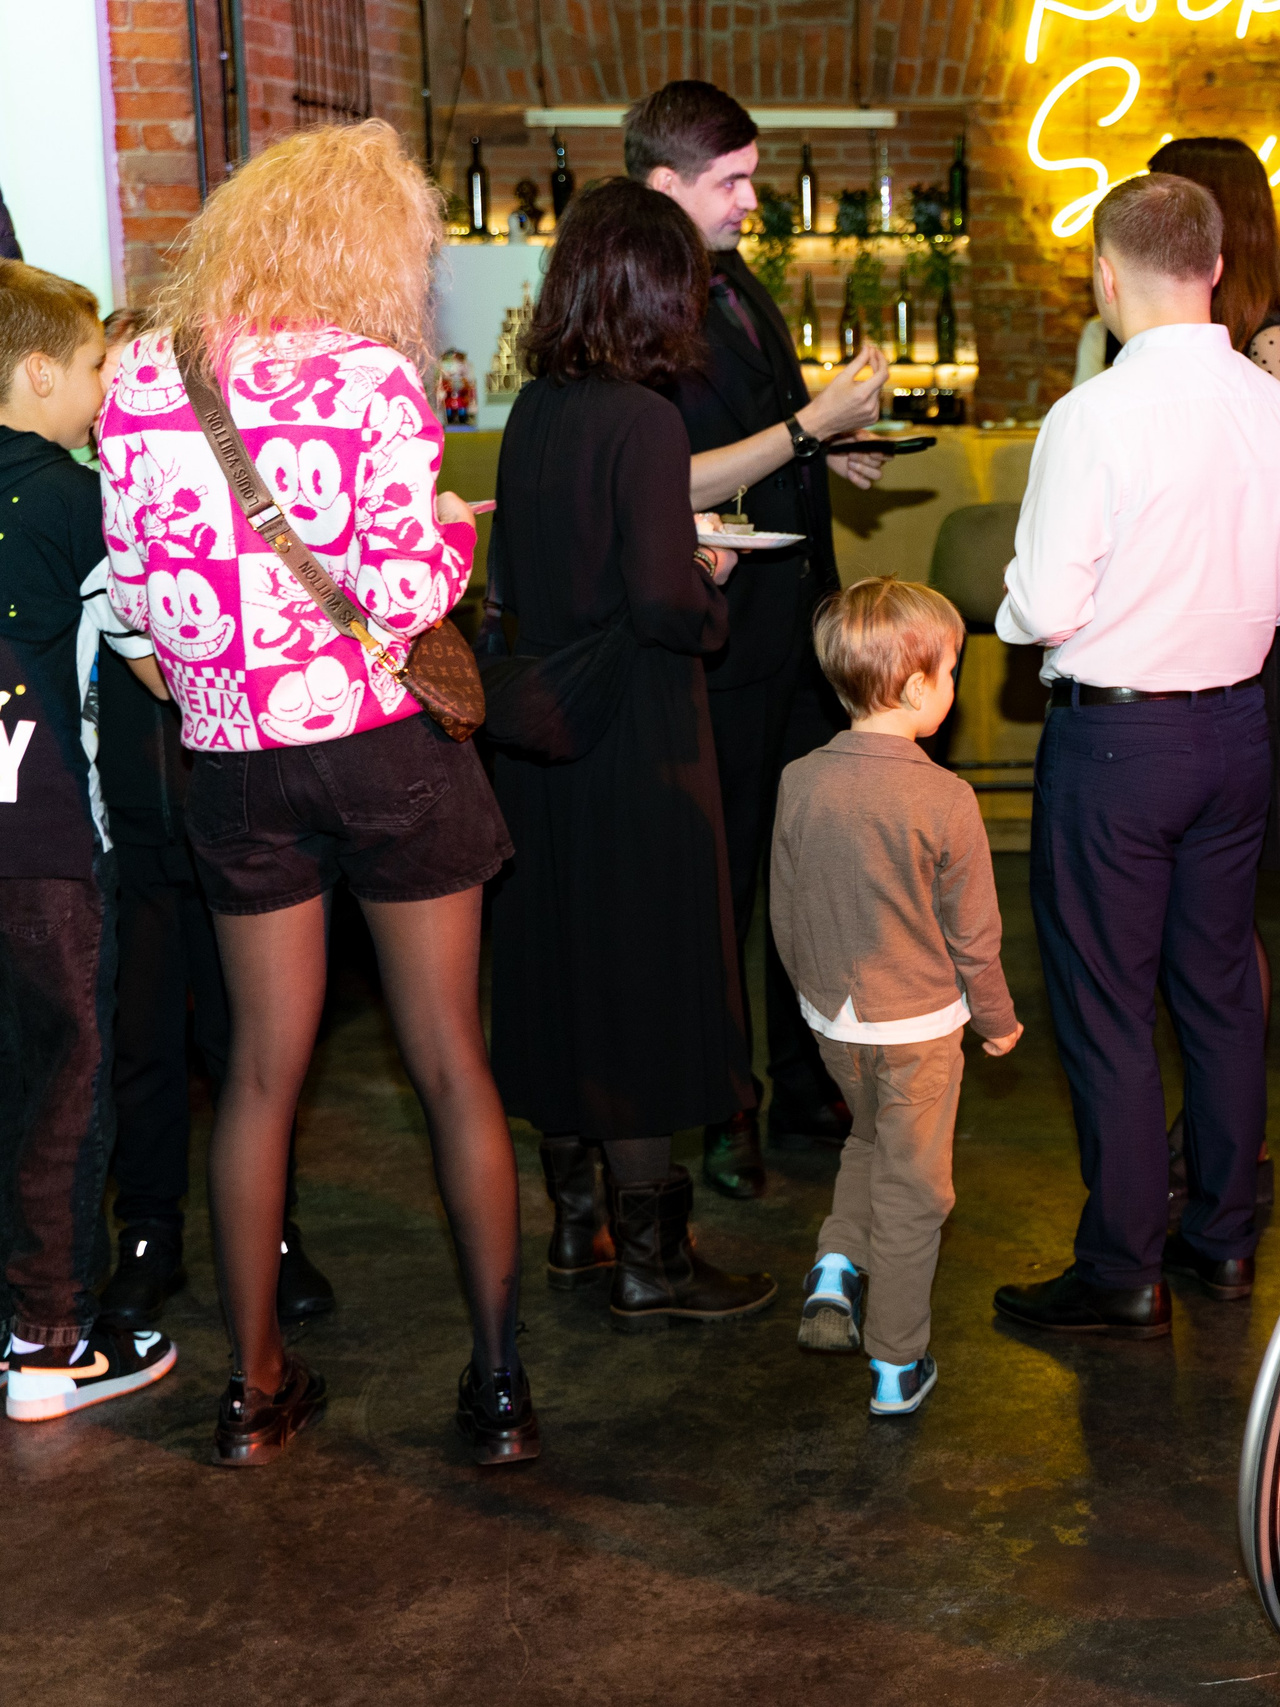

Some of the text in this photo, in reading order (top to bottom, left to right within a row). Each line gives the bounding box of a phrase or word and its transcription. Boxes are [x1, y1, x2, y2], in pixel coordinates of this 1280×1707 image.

[204, 409, 260, 508] LOUIS VUITTON
[298, 560, 343, 613] VUITTON
[177, 681, 250, 722] FELIX
[193, 716, 251, 751] CAT
